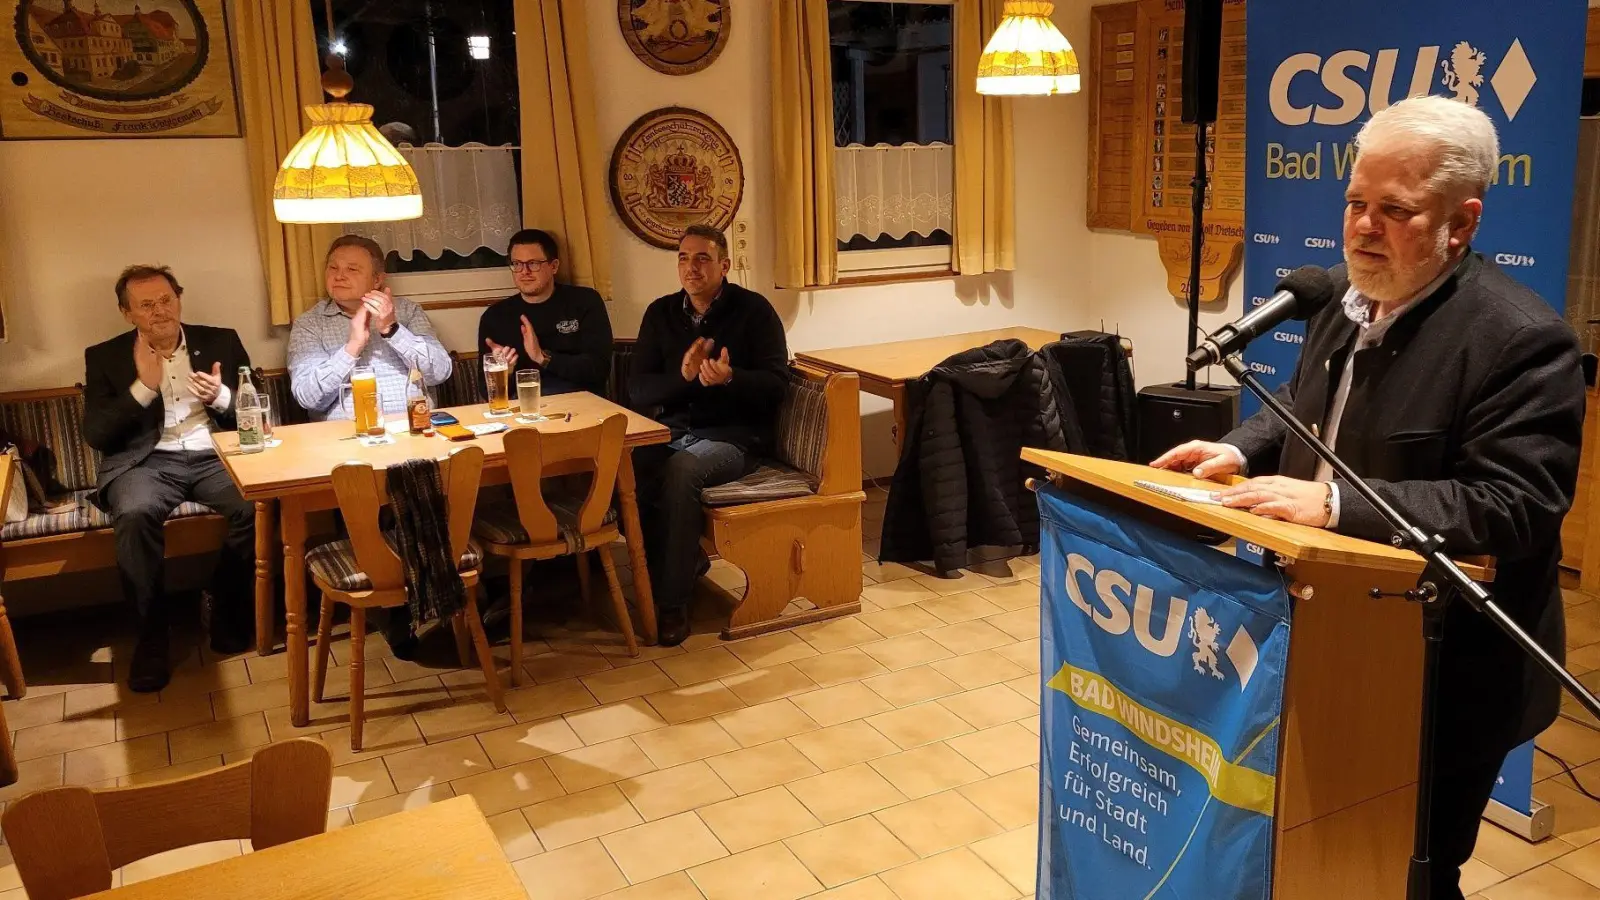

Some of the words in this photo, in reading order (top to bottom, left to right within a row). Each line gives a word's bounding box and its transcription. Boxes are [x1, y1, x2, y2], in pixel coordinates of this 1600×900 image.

[1269, 45, 1440, 126] CSU
[1266, 142, 1321, 180] Bad
[1147, 219, 1176, 233] Gegeben
[1254, 233, 1271, 244] CSU
[1305, 237, 1326, 248] CSU
[1495, 253, 1521, 266] CSU
[1274, 331, 1294, 343] CSU
[1251, 362, 1268, 374] CSU
[1246, 542, 1264, 556] CSU
[1065, 552, 1188, 657] CSU
[1070, 671, 1115, 710] BAD
[1072, 715, 1182, 797] Gemeinsam,
[1069, 741, 1168, 816] Erfolgreich
[1064, 770, 1091, 799] für
[1095, 790, 1148, 834] Stadt
[1060, 803, 1097, 834] und
[1103, 823, 1152, 870] Land.
